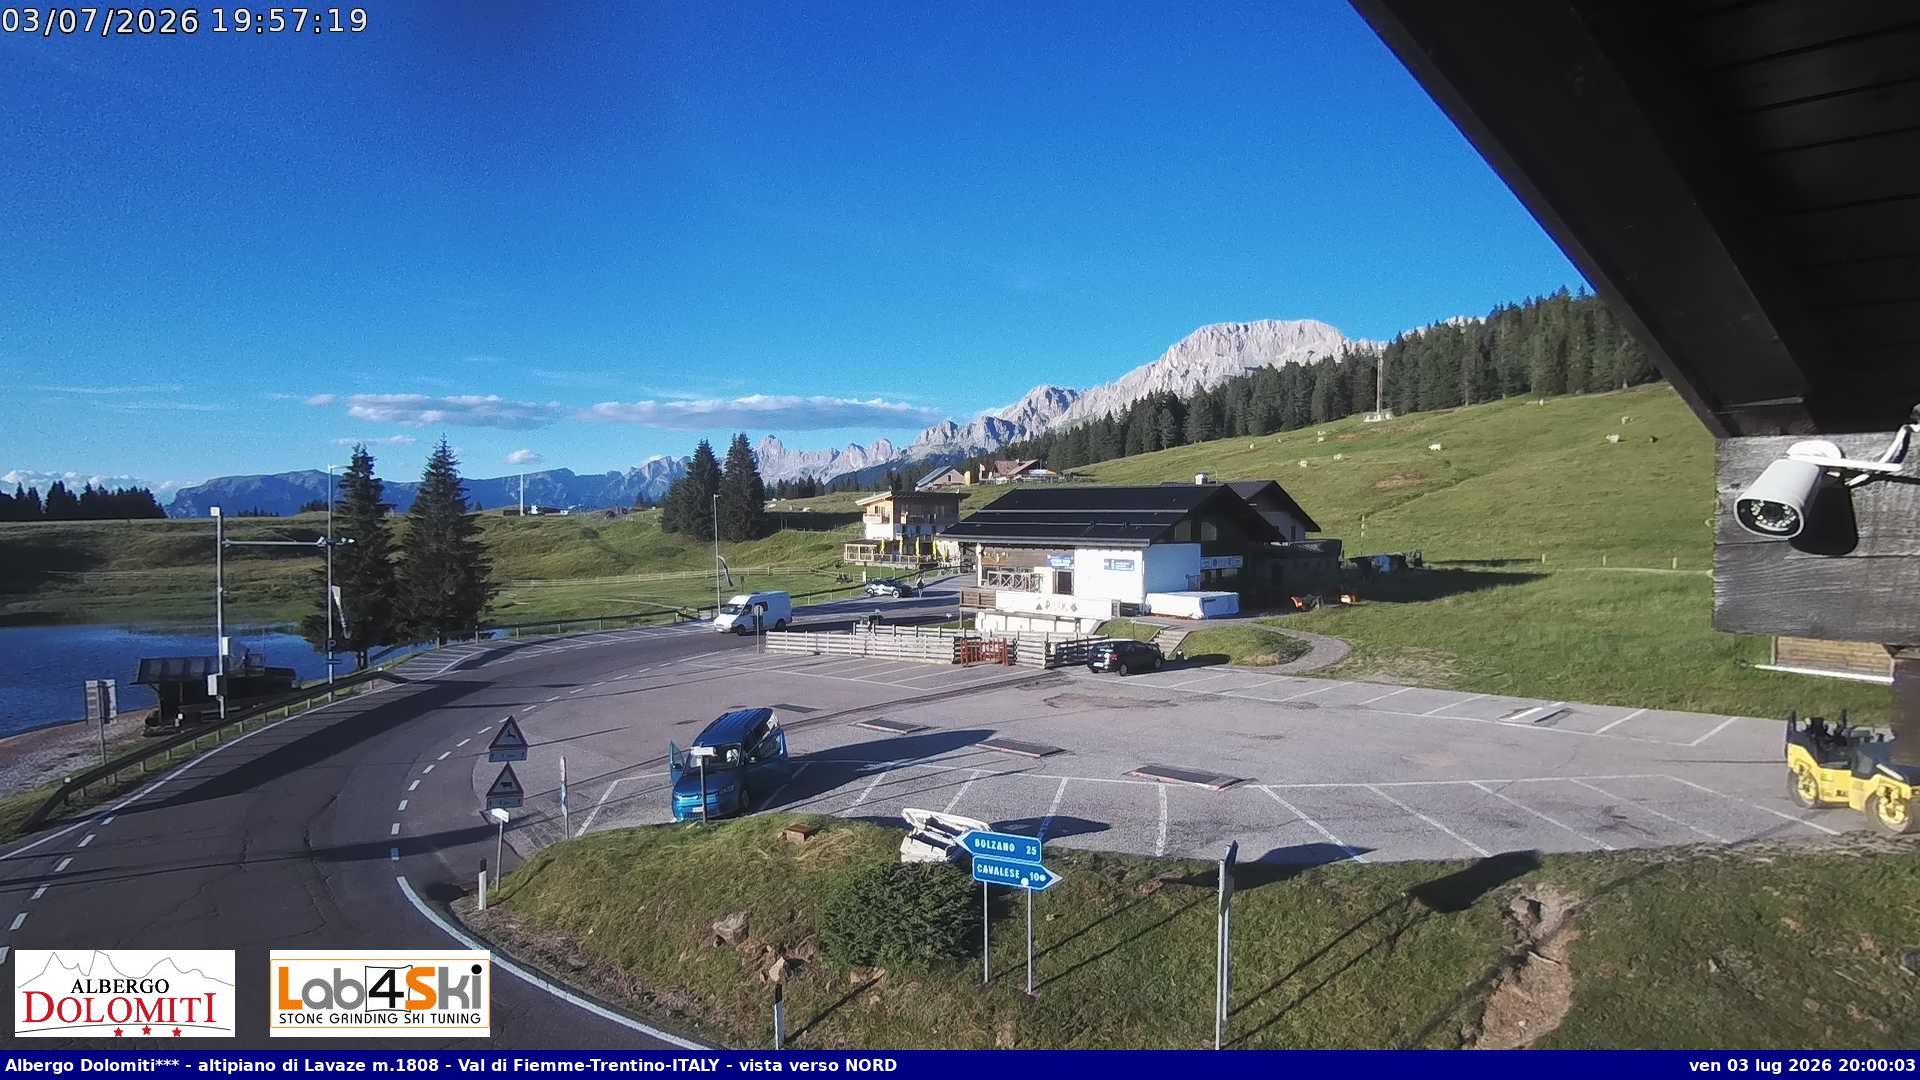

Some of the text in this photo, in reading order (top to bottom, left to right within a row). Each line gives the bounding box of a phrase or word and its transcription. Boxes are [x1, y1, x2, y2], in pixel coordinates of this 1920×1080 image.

[975, 838, 1037, 856] BOLZANO 25
[977, 864, 1040, 882] CAVALESE 10
